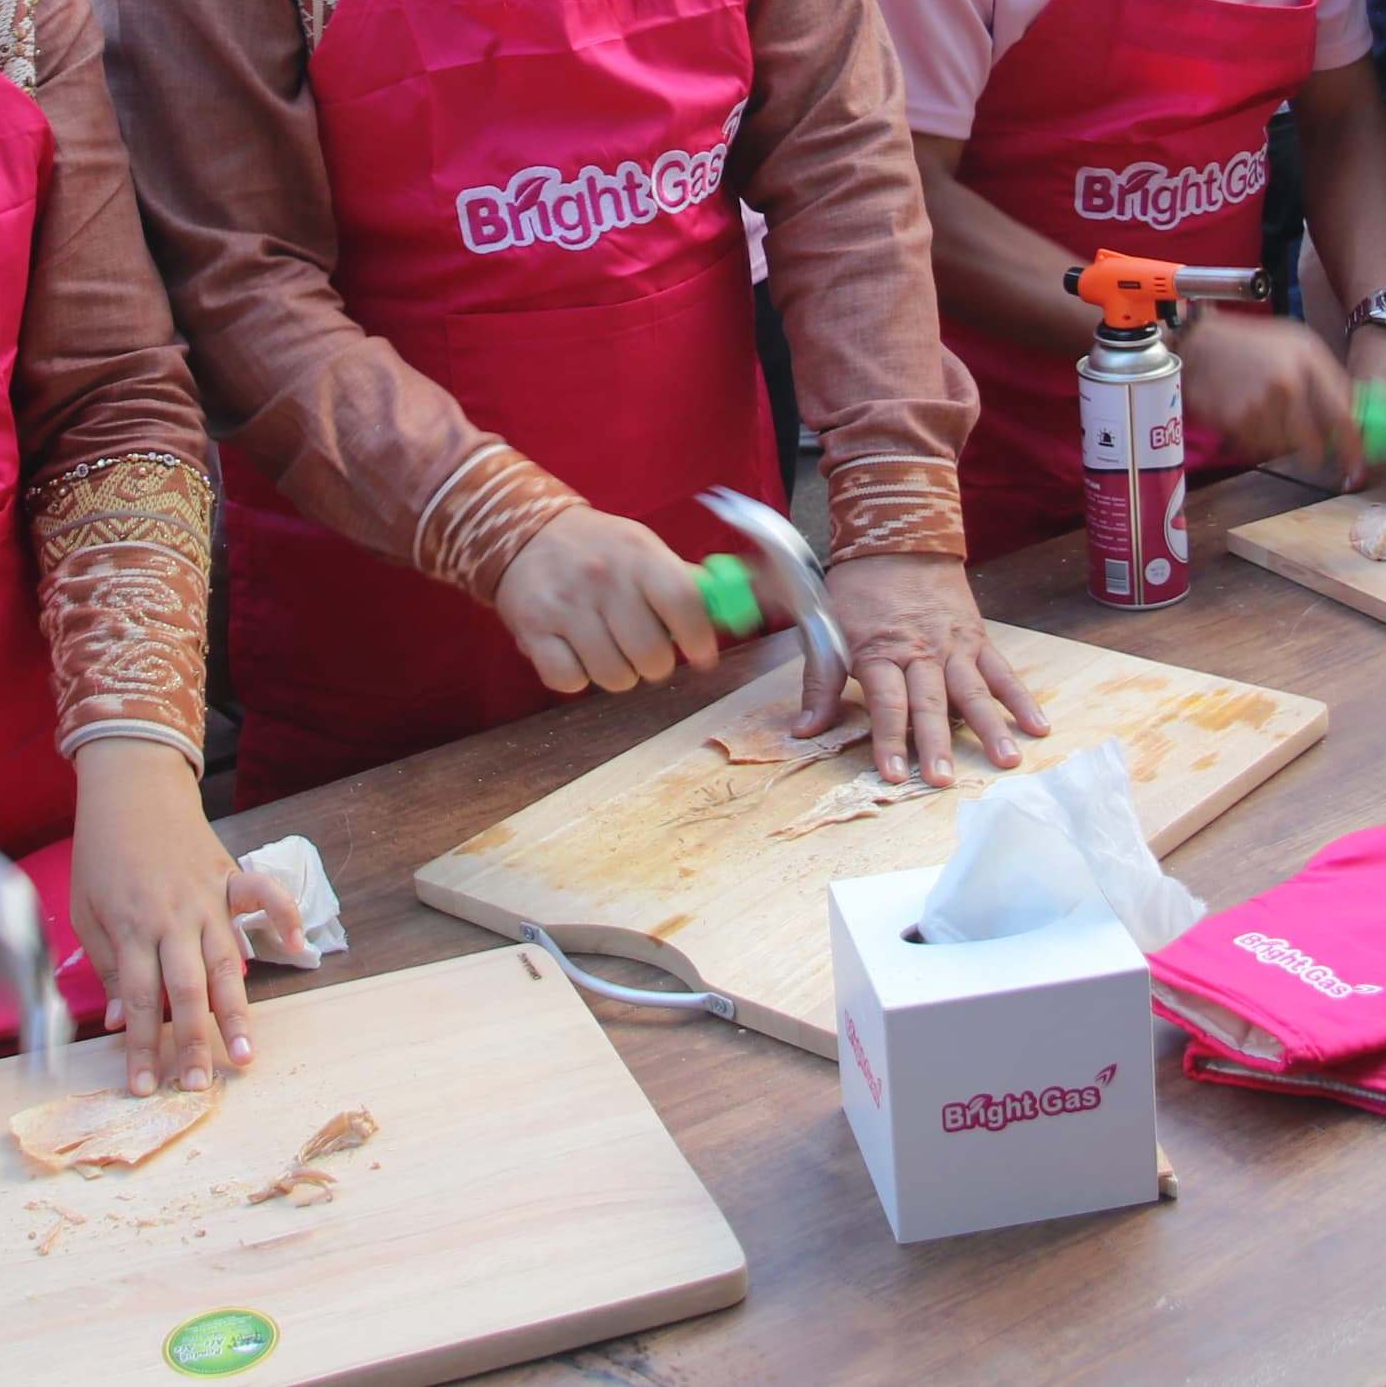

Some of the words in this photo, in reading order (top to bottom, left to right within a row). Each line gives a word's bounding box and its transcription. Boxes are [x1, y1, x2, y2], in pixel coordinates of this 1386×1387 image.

[456, 162, 657, 254] Bright
[651, 144, 727, 214] Gas
[1075, 161, 1223, 230] Bright
[1233, 932, 1313, 974] Bright
[1300, 965, 1354, 998] Gas
[942, 1093, 1039, 1132] Bright
[1039, 1086, 1101, 1116] Gas
